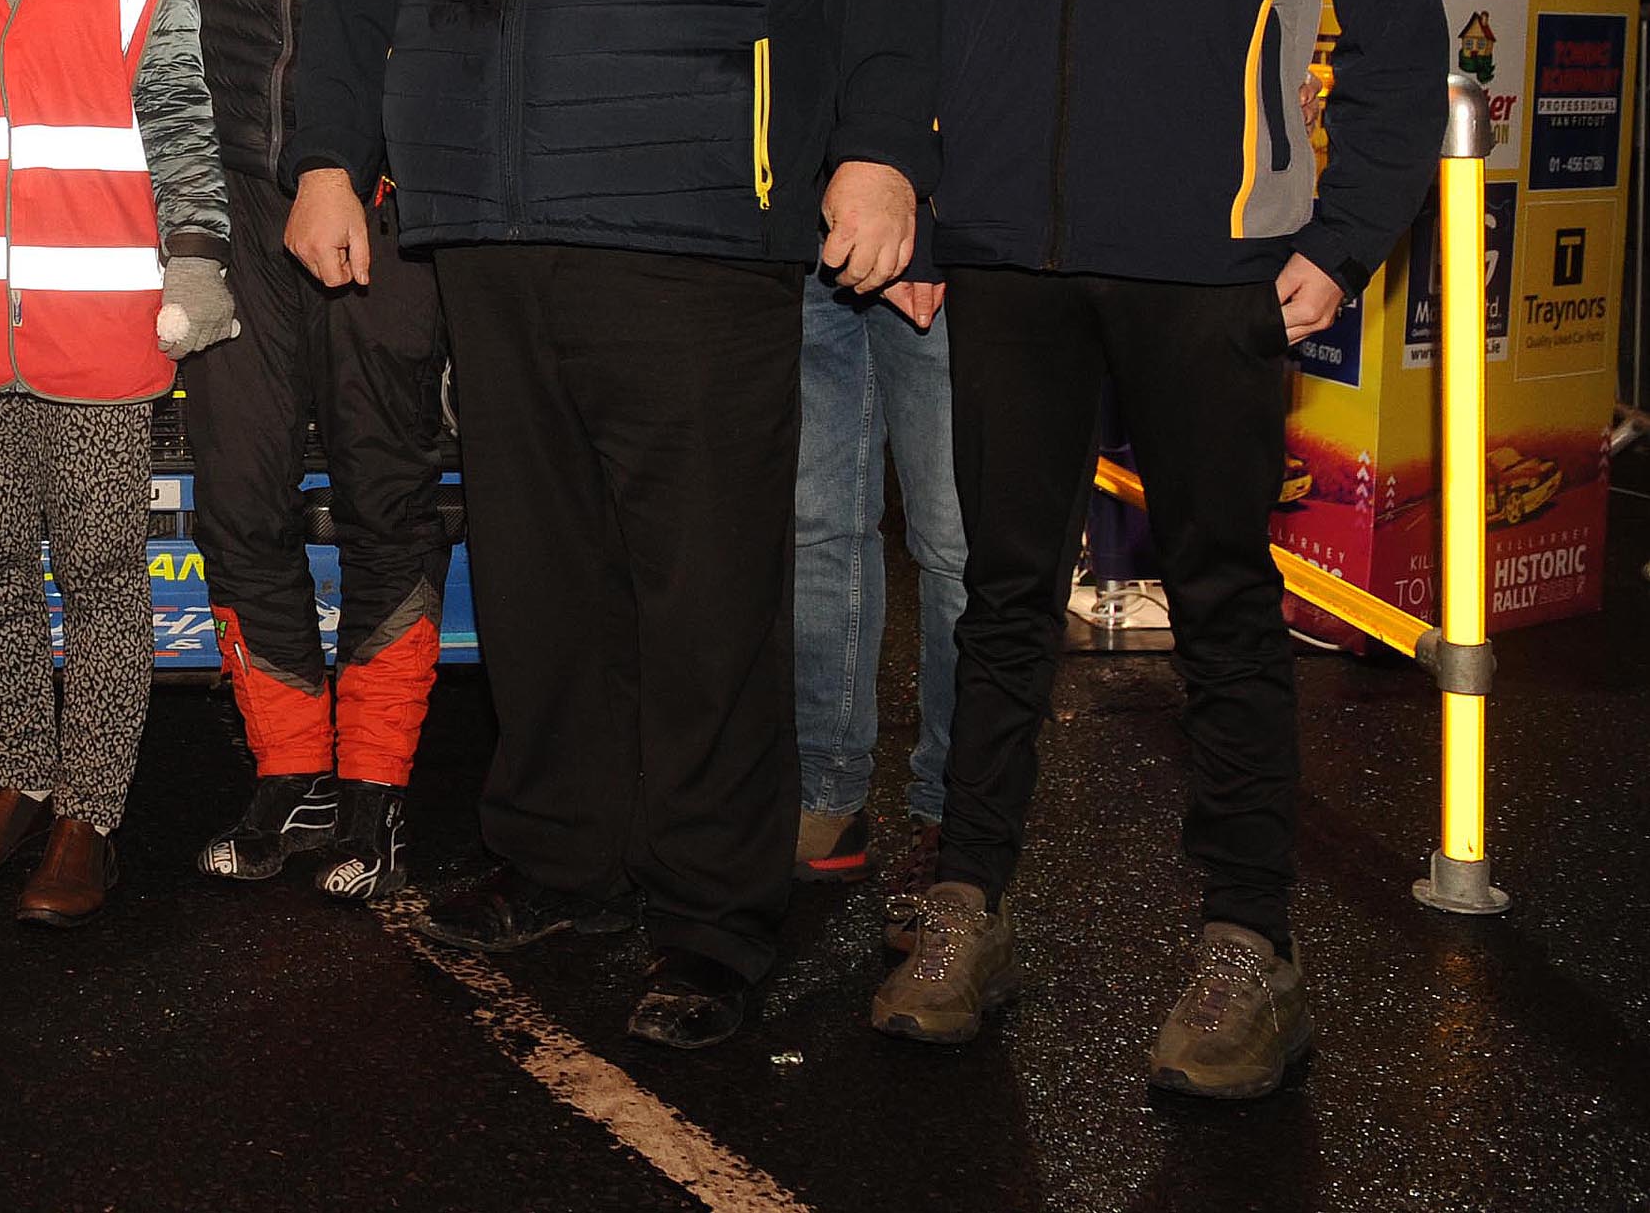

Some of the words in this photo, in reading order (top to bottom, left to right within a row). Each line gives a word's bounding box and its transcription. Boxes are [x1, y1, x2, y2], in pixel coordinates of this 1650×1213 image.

[1538, 100, 1617, 113] PROFESSIONAL
[1523, 293, 1607, 331] Traynors
[1494, 544, 1587, 590] HISTORIC
[1492, 584, 1538, 614] RALLY
[212, 841, 233, 875] OMP
[328, 860, 366, 893] OMP
